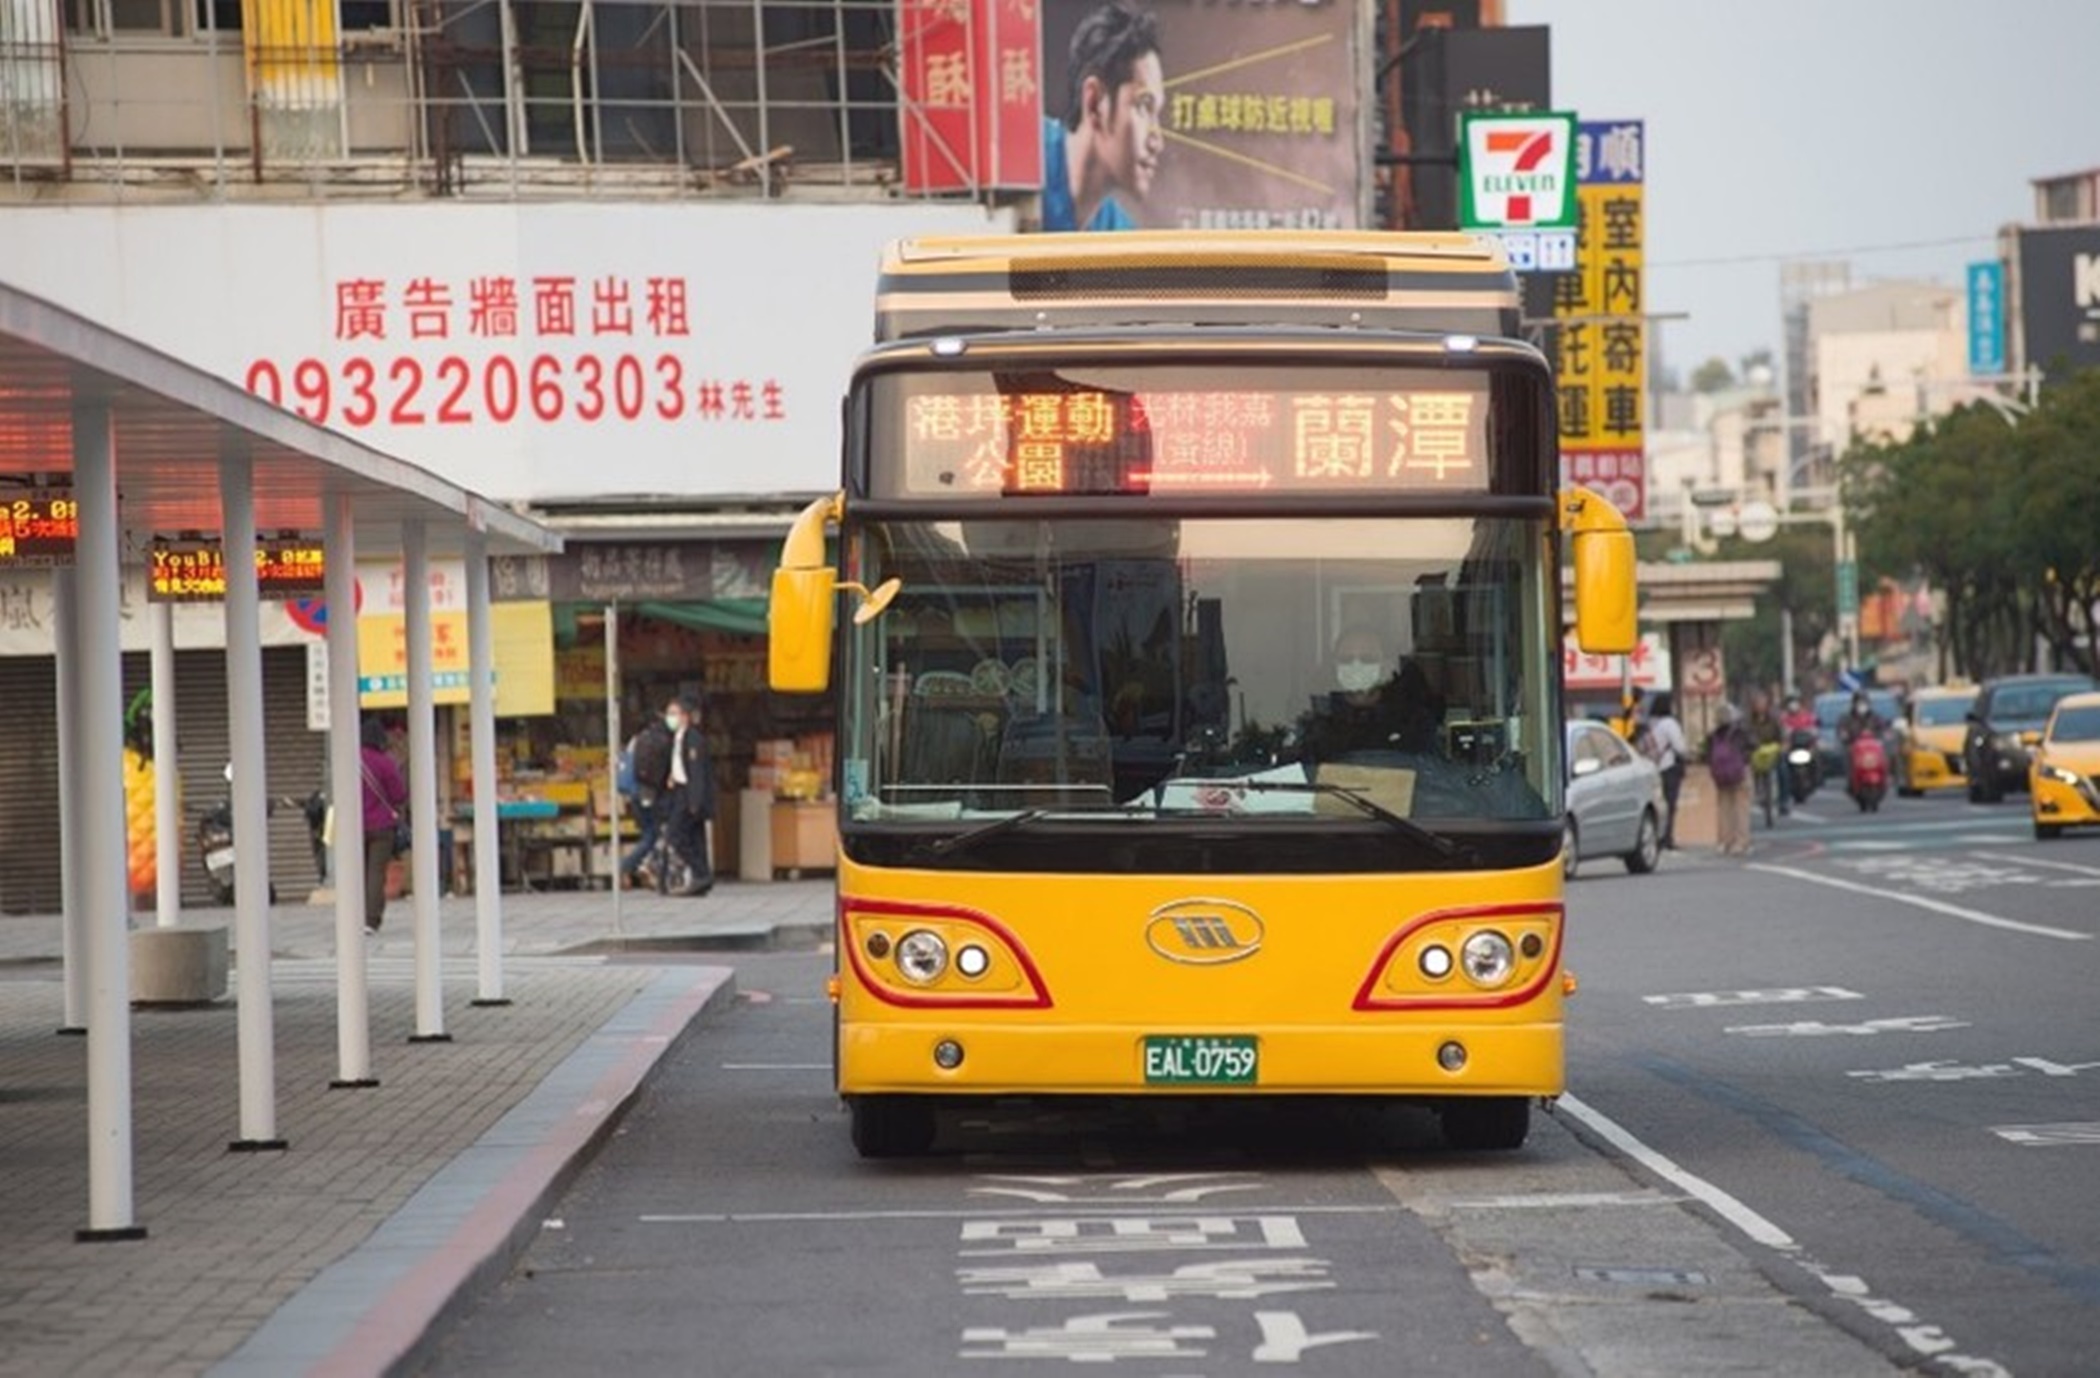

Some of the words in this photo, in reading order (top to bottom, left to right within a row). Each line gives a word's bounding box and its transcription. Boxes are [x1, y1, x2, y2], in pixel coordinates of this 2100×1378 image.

[1602, 195, 1642, 438] 室內寄車
[245, 353, 686, 428] 0932206303
[697, 379, 787, 422] 林先生
[912, 392, 1114, 442] 港坪運動
[964, 439, 1064, 490] 公園
[1292, 393, 1474, 480] 蘭潭
[1146, 1047, 1255, 1077] EAL-0759
